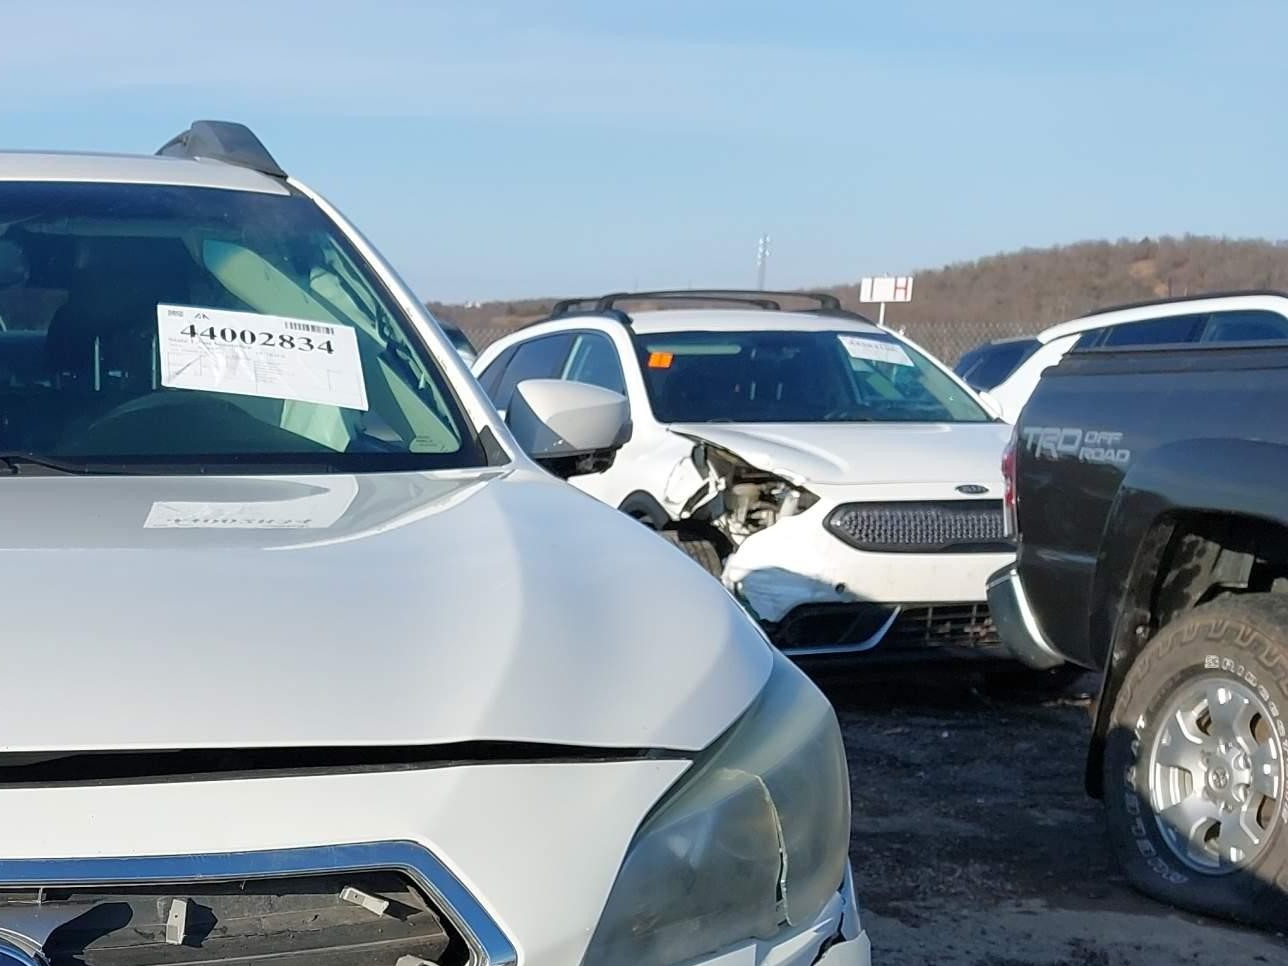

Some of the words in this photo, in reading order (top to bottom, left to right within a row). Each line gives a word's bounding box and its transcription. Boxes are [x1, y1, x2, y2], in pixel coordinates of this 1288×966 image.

[893, 276, 909, 301] H
[180, 323, 335, 355] 44002834
[1023, 426, 1082, 461] TRD
[1083, 430, 1124, 444] OFF
[1078, 447, 1131, 463] ROAD
